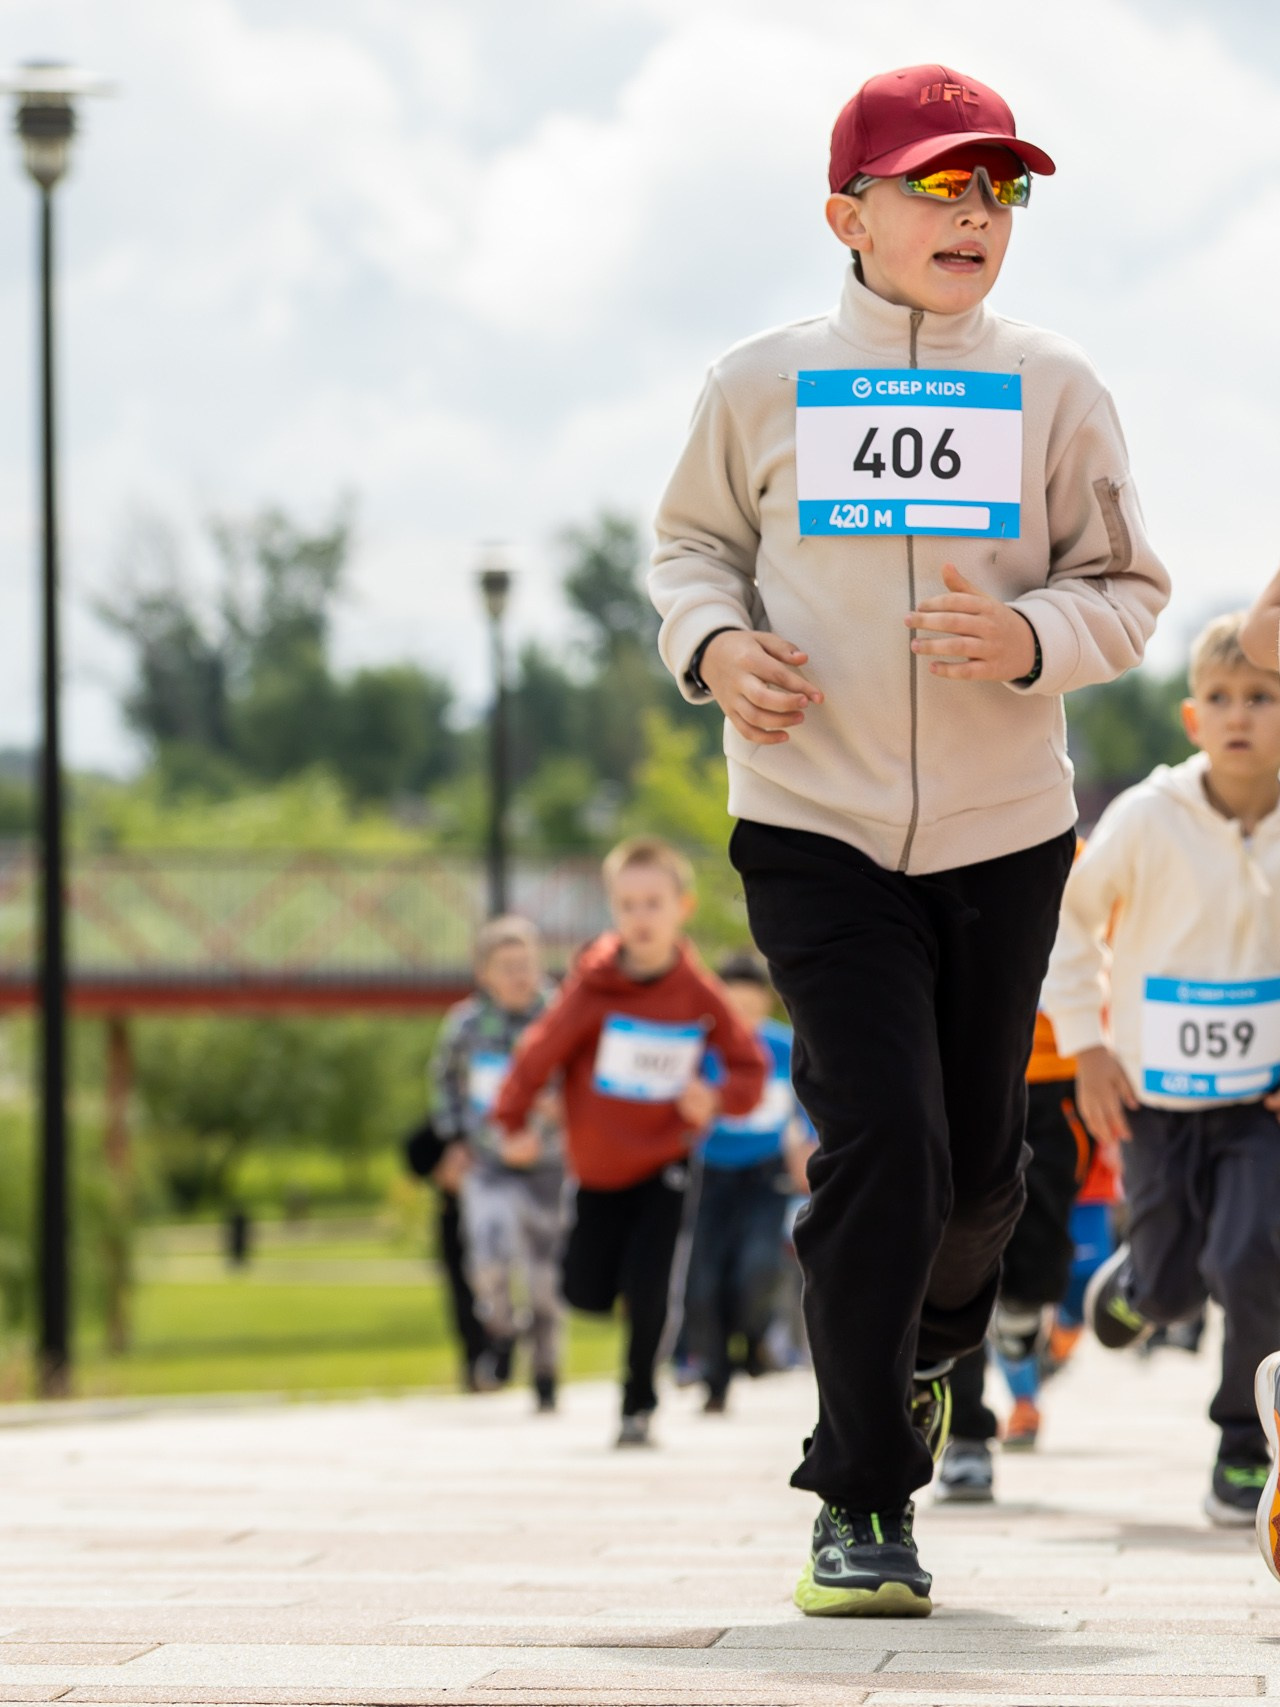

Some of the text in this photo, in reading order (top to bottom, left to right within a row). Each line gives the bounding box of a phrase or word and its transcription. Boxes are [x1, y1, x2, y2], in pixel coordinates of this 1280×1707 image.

[920, 83, 979, 107] UFC
[875, 380, 966, 397] СБЕР KIDS
[853, 427, 961, 479] 406
[829, 504, 869, 528] 420
[1178, 1020, 1256, 1058] 059
